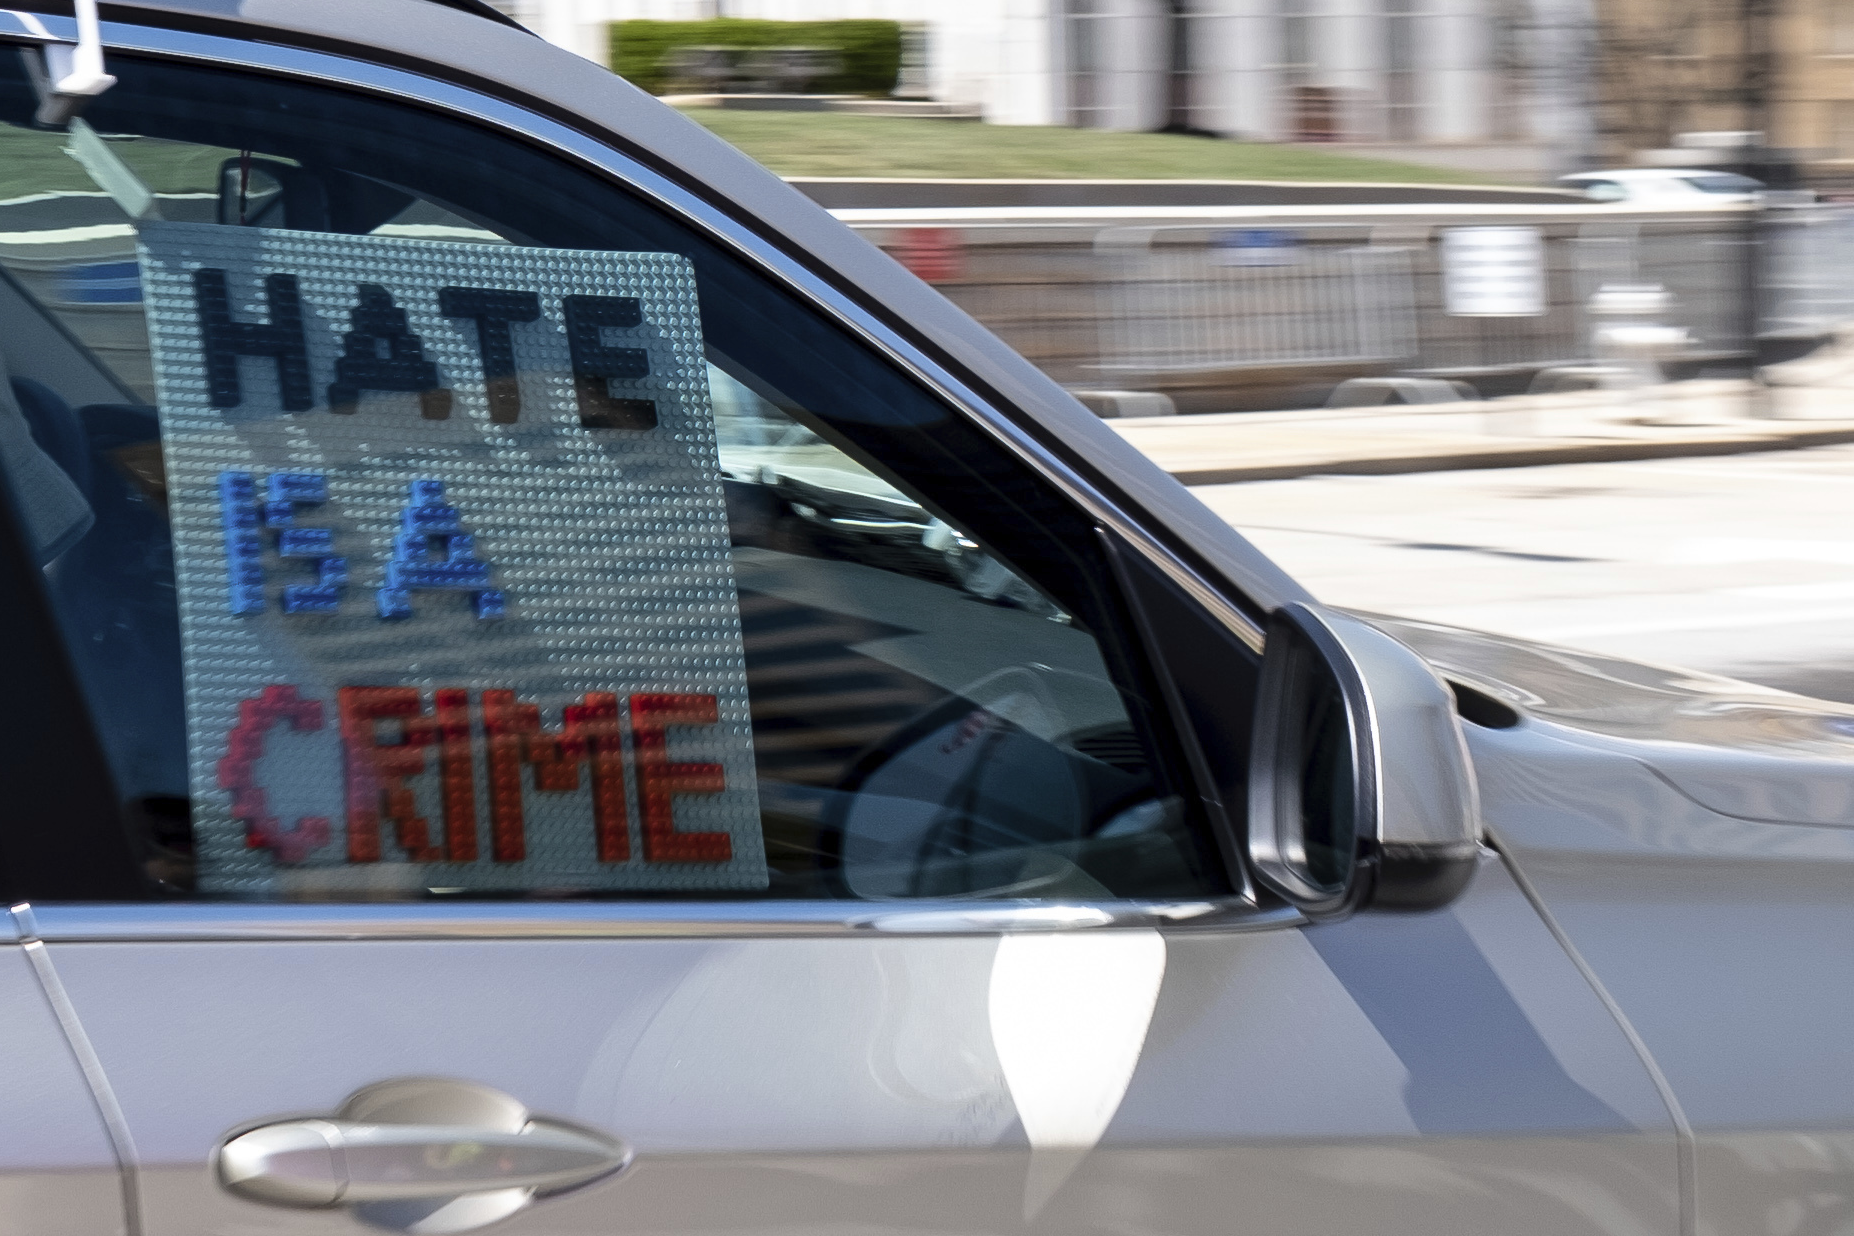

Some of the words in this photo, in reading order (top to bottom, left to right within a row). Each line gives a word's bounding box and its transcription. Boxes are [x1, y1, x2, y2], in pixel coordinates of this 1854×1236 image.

[193, 267, 659, 431] HATE
[218, 470, 346, 617] IS
[376, 478, 506, 620] A
[217, 683, 734, 864] CRIME
